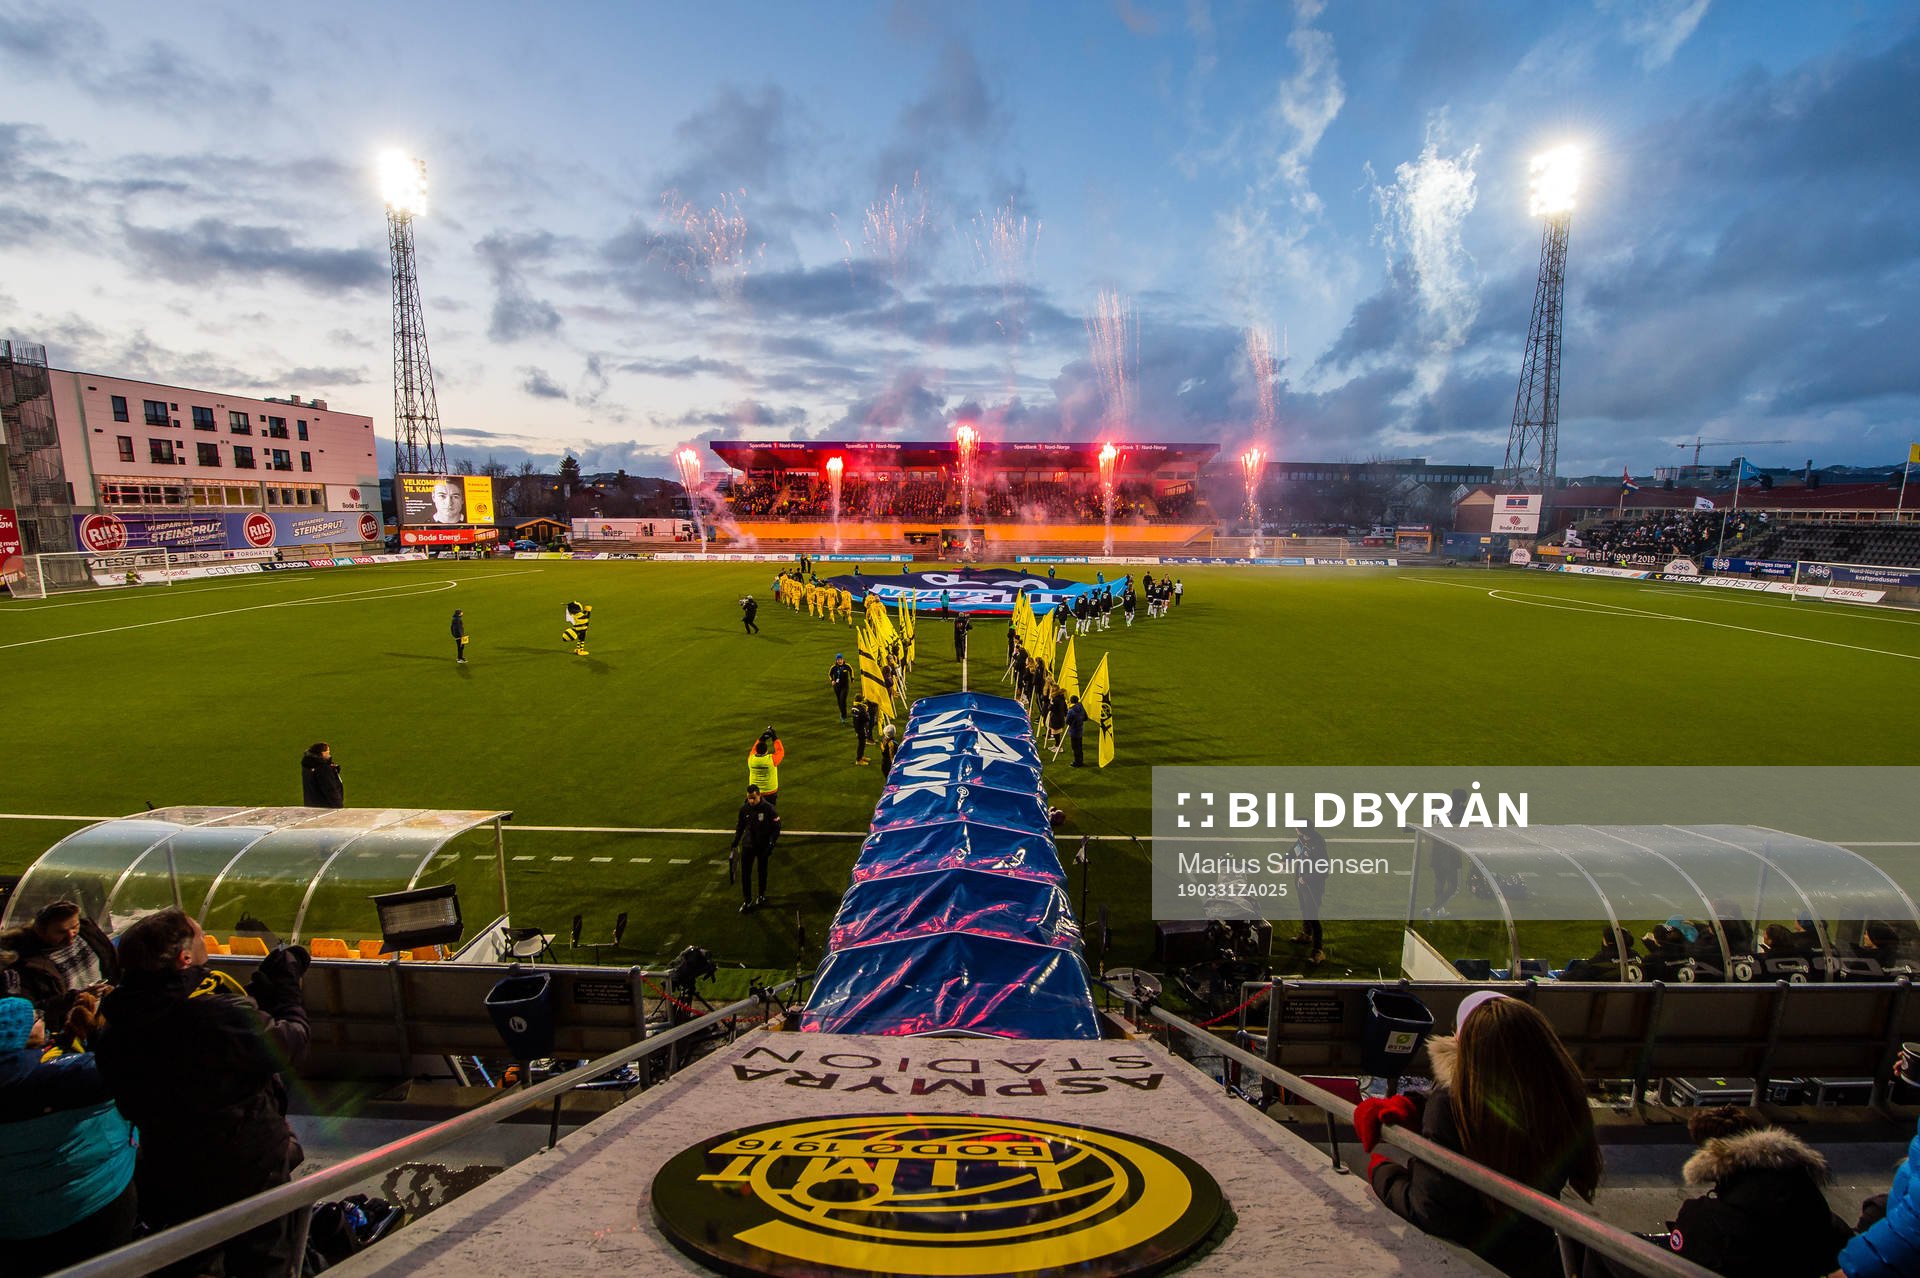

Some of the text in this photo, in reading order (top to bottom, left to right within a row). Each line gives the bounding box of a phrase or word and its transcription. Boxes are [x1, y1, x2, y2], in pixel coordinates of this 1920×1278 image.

[355, 502, 369, 510] Energi
[151, 522, 221, 542] STEINSPRUT
[249, 522, 271, 537] RIIS
[294, 520, 344, 537] STEINSPRUT
[362, 521, 377, 533] RIIS
[88, 524, 121, 542] RIIS
[141, 554, 177, 564] TESS
[237, 550, 276, 558] TORGHATTEN
[1638, 555, 1656, 563] 2019
[99, 557, 134, 567] TESS
[1849, 568, 1886, 576] Nord-Norges
[1664, 574, 1702, 583] DIADORA
[1855, 575, 1900, 584] kraftprodusent
[1830, 588, 1868, 598] Scandic
[741, 1046, 1156, 1074] STADION
[732, 1062, 1165, 1097] ASPMYRA
[736, 1138, 1043, 1158] BODØ 1916
